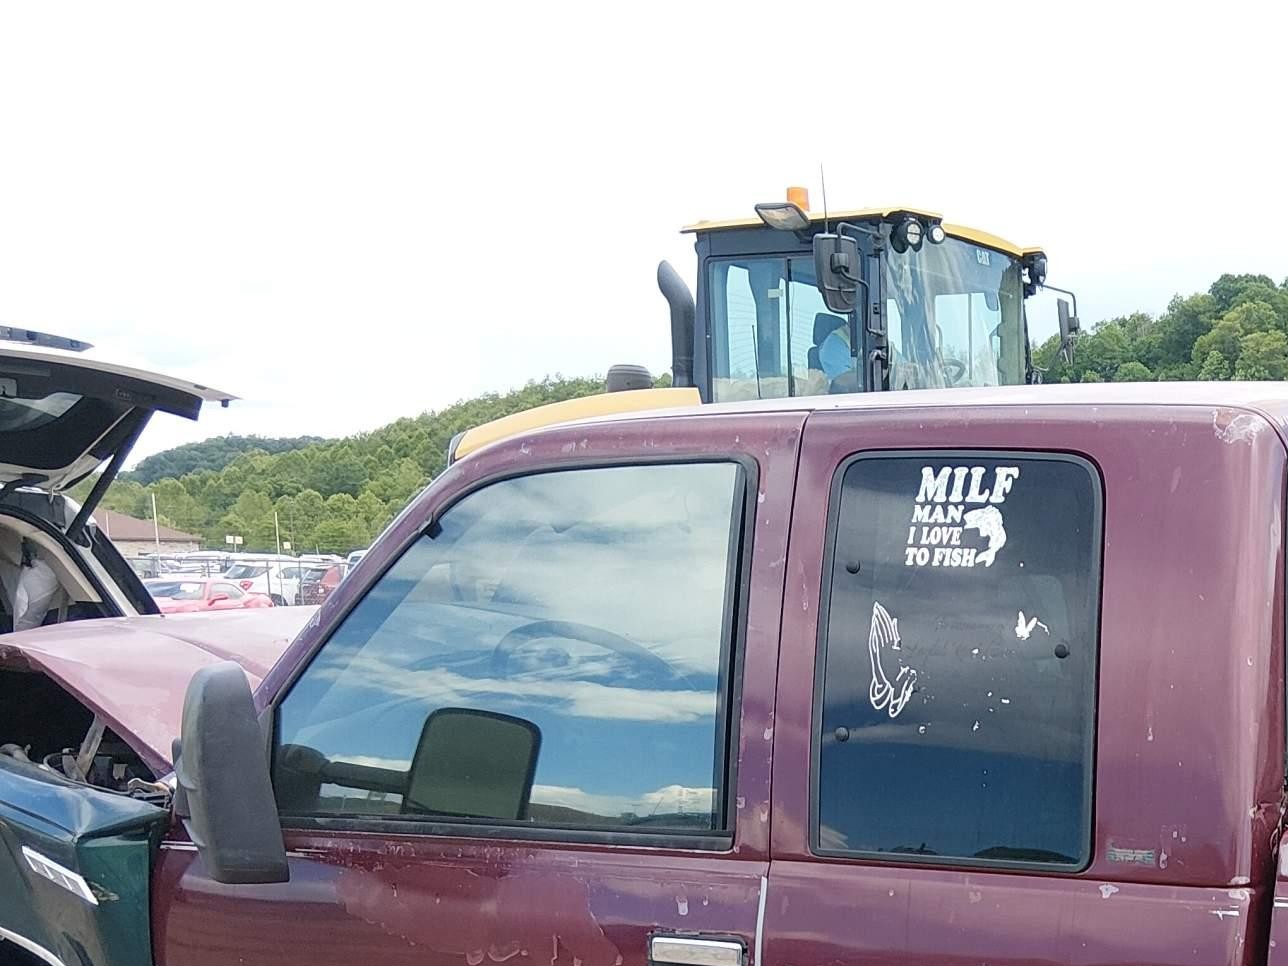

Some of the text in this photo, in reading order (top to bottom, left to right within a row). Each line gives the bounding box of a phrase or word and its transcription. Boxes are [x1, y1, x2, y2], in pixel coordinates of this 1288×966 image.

[976, 248, 990, 266] CAT
[915, 466, 1020, 503] MILF
[912, 505, 965, 523] MAN
[907, 526, 962, 546] I LOVE
[905, 547, 977, 567] TO FISH
